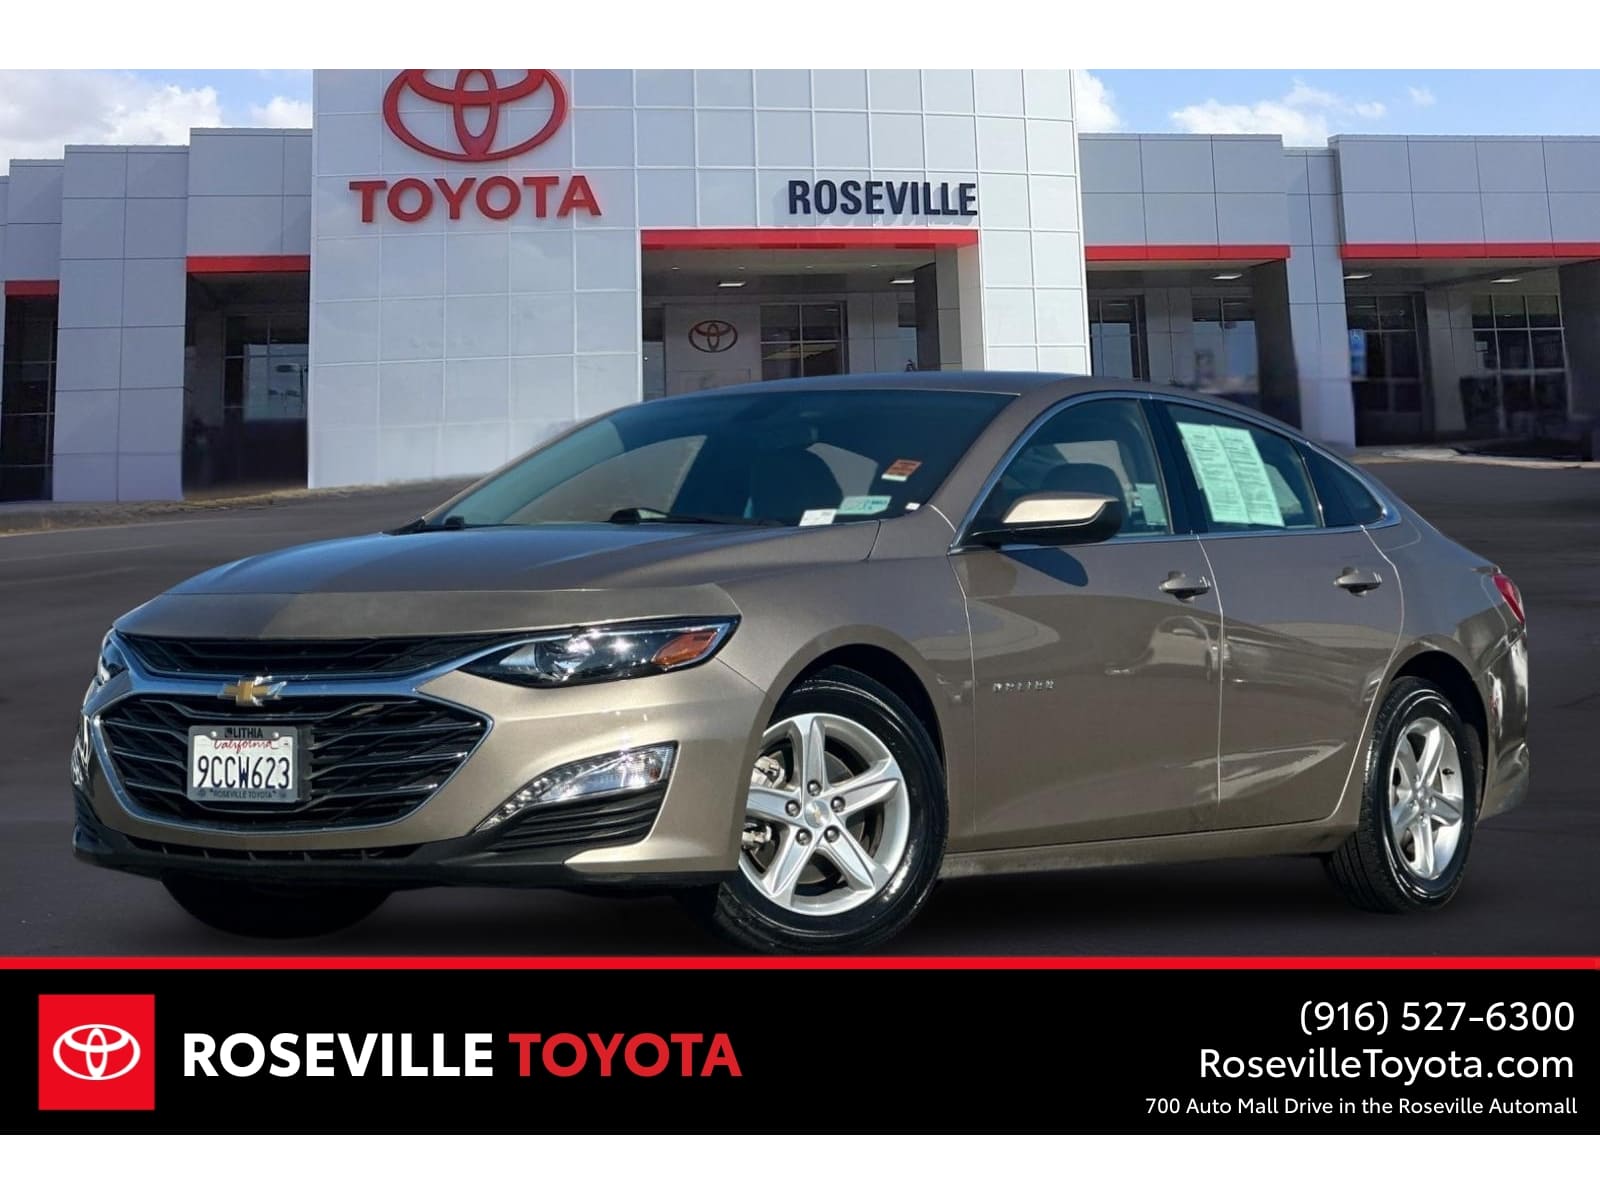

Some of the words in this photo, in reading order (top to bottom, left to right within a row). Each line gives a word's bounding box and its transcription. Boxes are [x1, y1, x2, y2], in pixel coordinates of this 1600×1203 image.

[349, 175, 602, 223] TOYOTA
[788, 179, 978, 216] ROSEVILLE
[213, 739, 278, 754] California
[232, 727, 264, 739] LITHIA
[197, 755, 291, 789] 9CCW623
